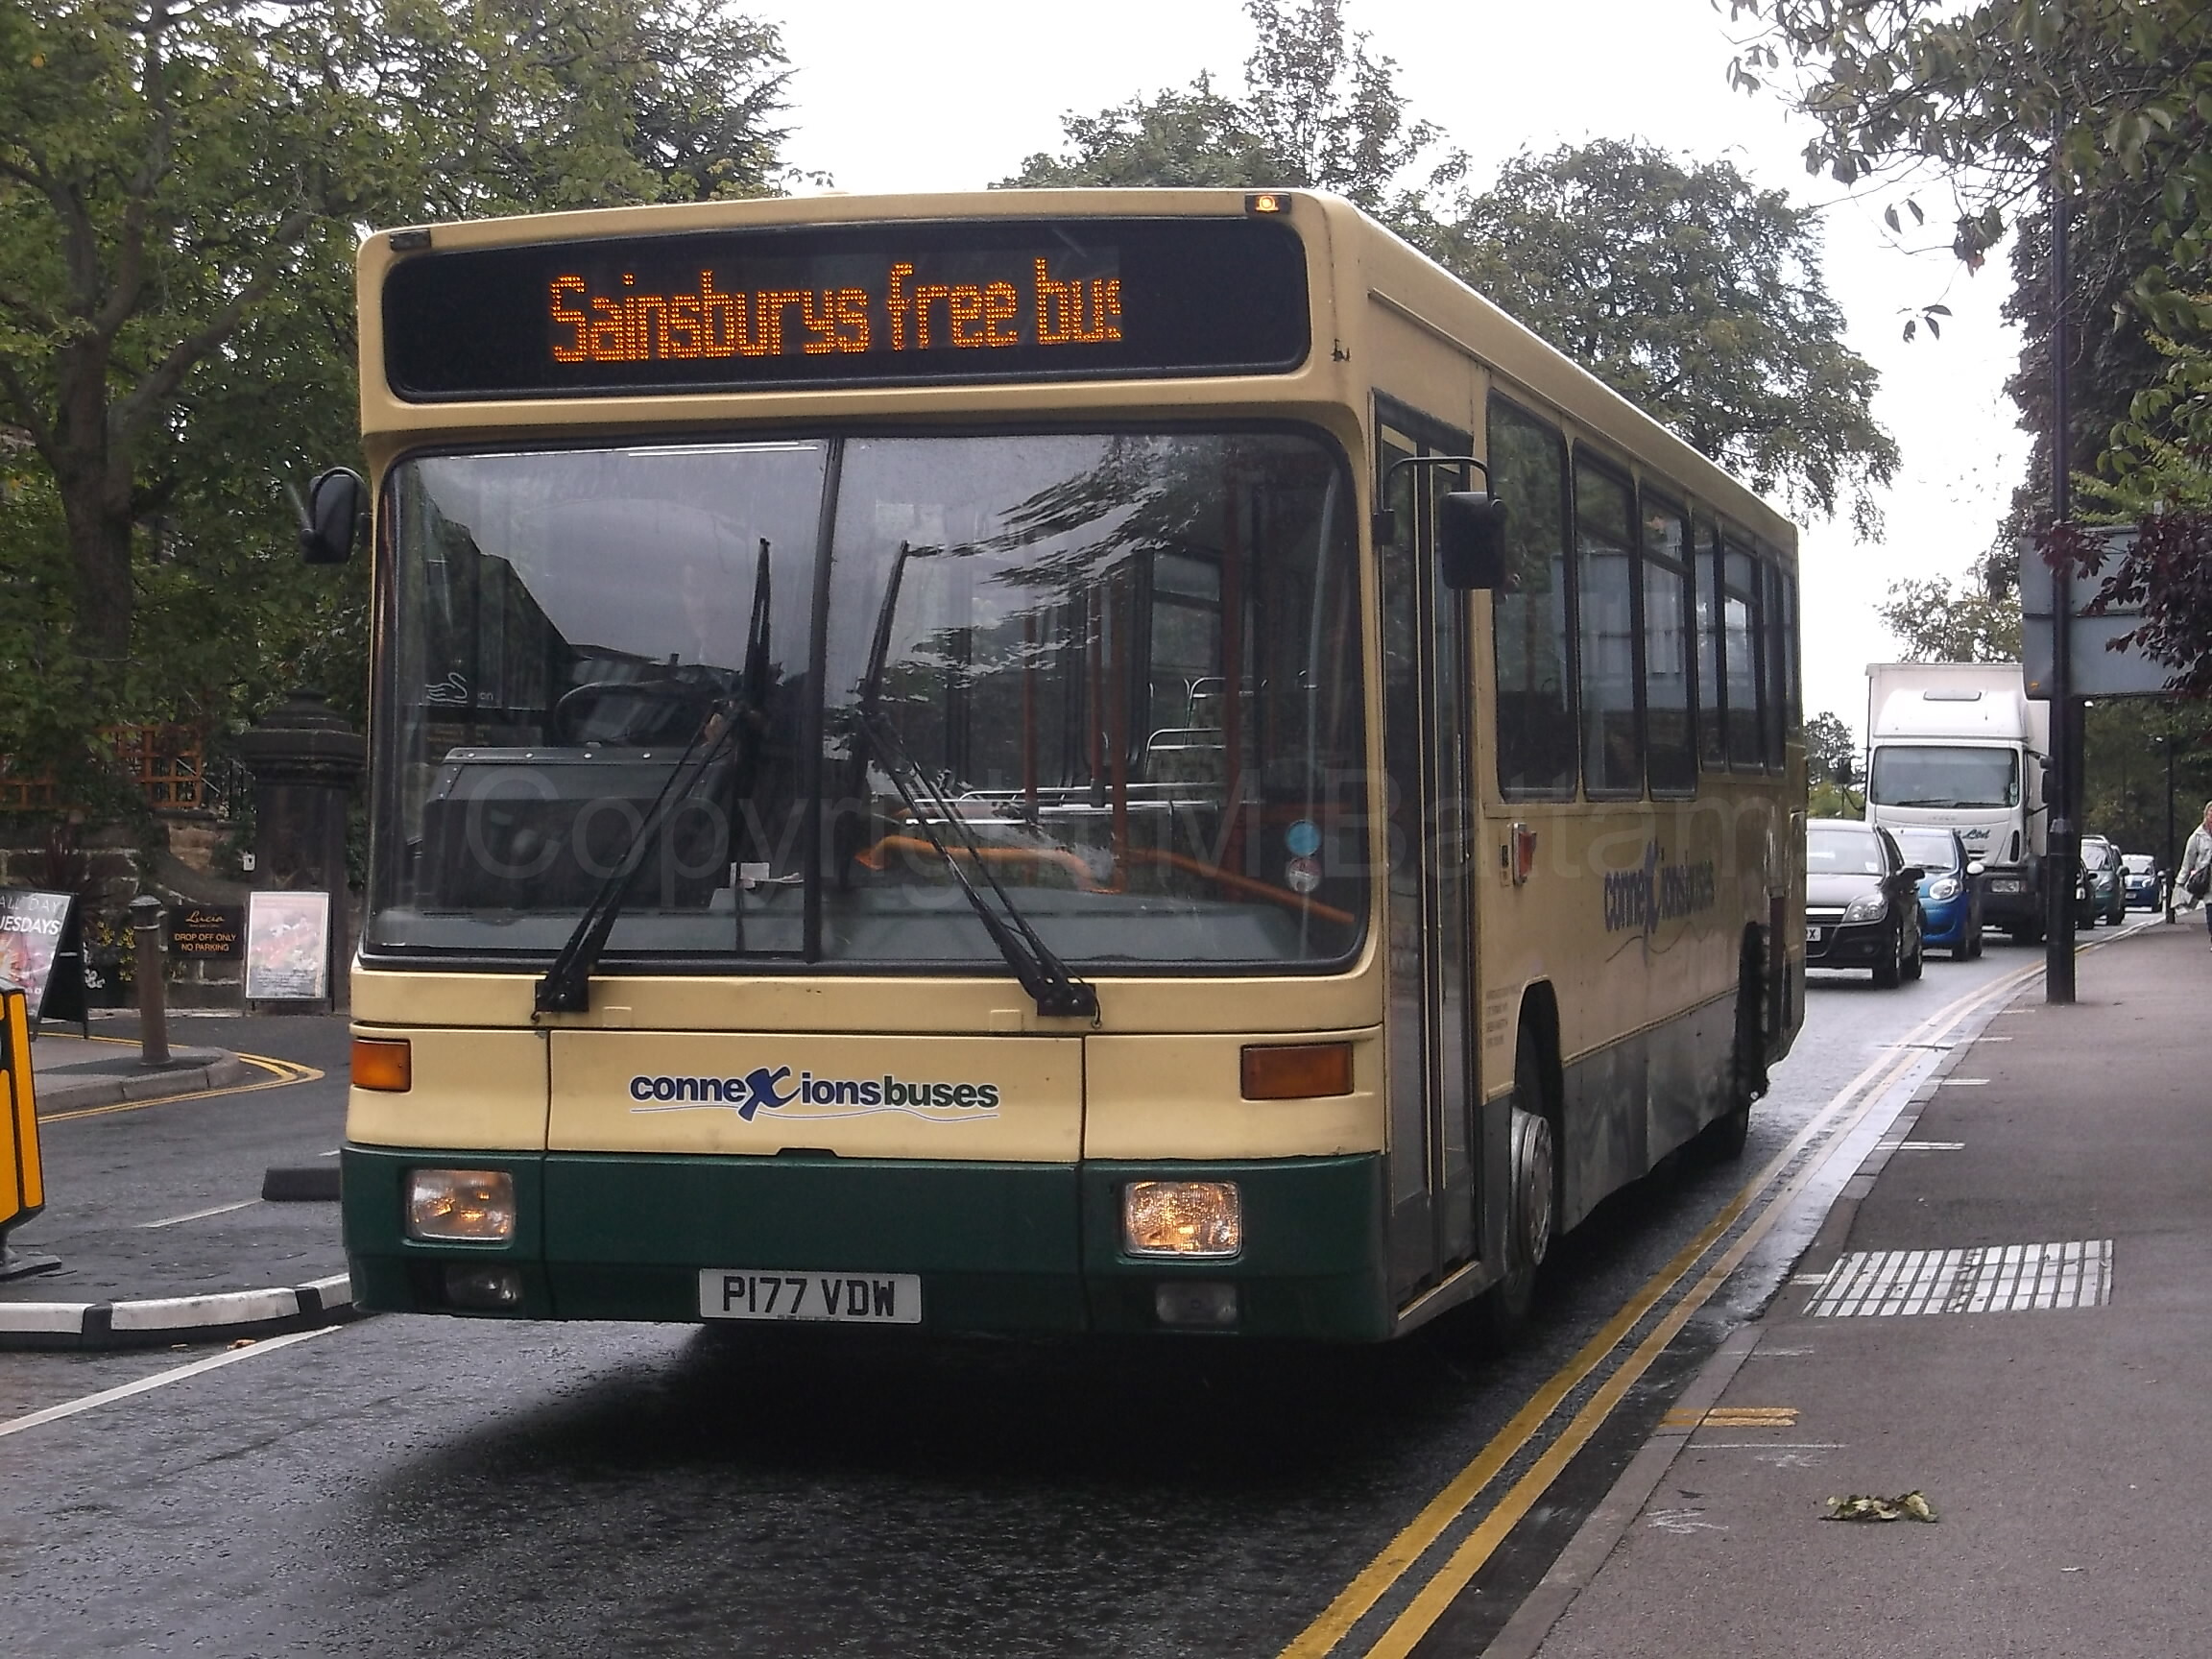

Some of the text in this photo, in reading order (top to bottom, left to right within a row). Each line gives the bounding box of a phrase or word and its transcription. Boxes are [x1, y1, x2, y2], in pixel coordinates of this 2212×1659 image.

[549, 269, 870, 364] Sainsburys
[886, 262, 1019, 351] free
[29, 897, 61, 913] DAY
[174, 932, 237, 943] DROP OFF ONLY
[180, 943, 230, 952] NO PARKING
[722, 1275, 896, 1317] P177 VDW
